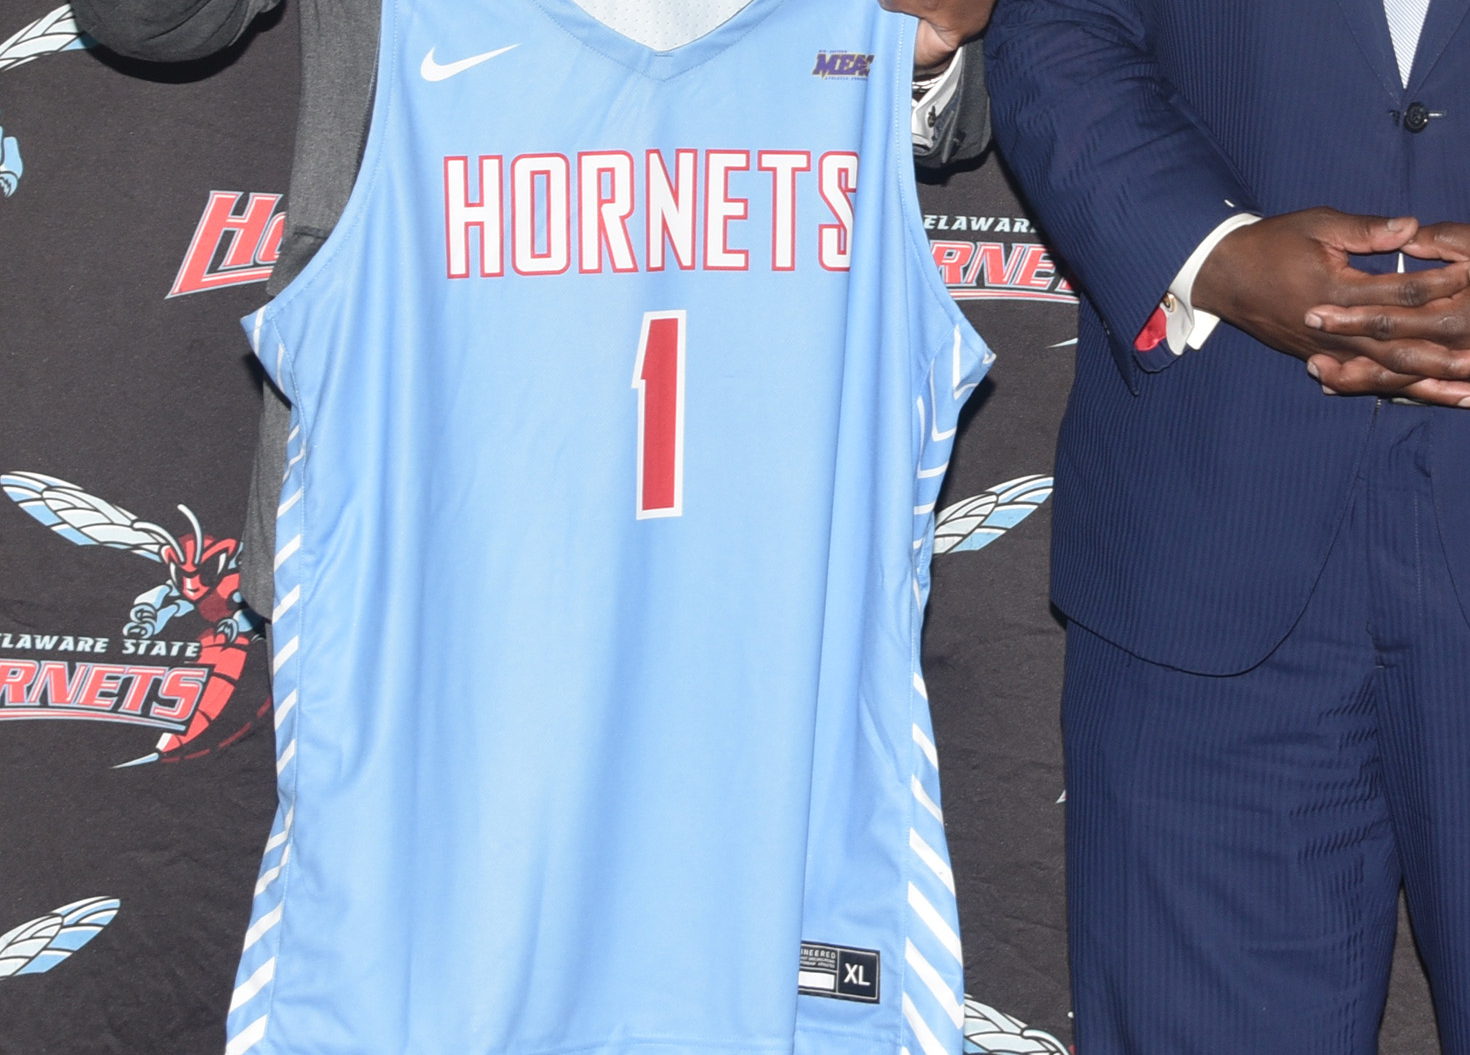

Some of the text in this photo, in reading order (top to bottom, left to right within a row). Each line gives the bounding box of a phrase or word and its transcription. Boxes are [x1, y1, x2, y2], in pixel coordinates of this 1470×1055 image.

[443, 148, 859, 279] HORNETS
[631, 309, 687, 520] 1
[122, 639, 200, 657] STATE
[0, 658, 209, 731] RNETS
[844, 963, 871, 986] XL
